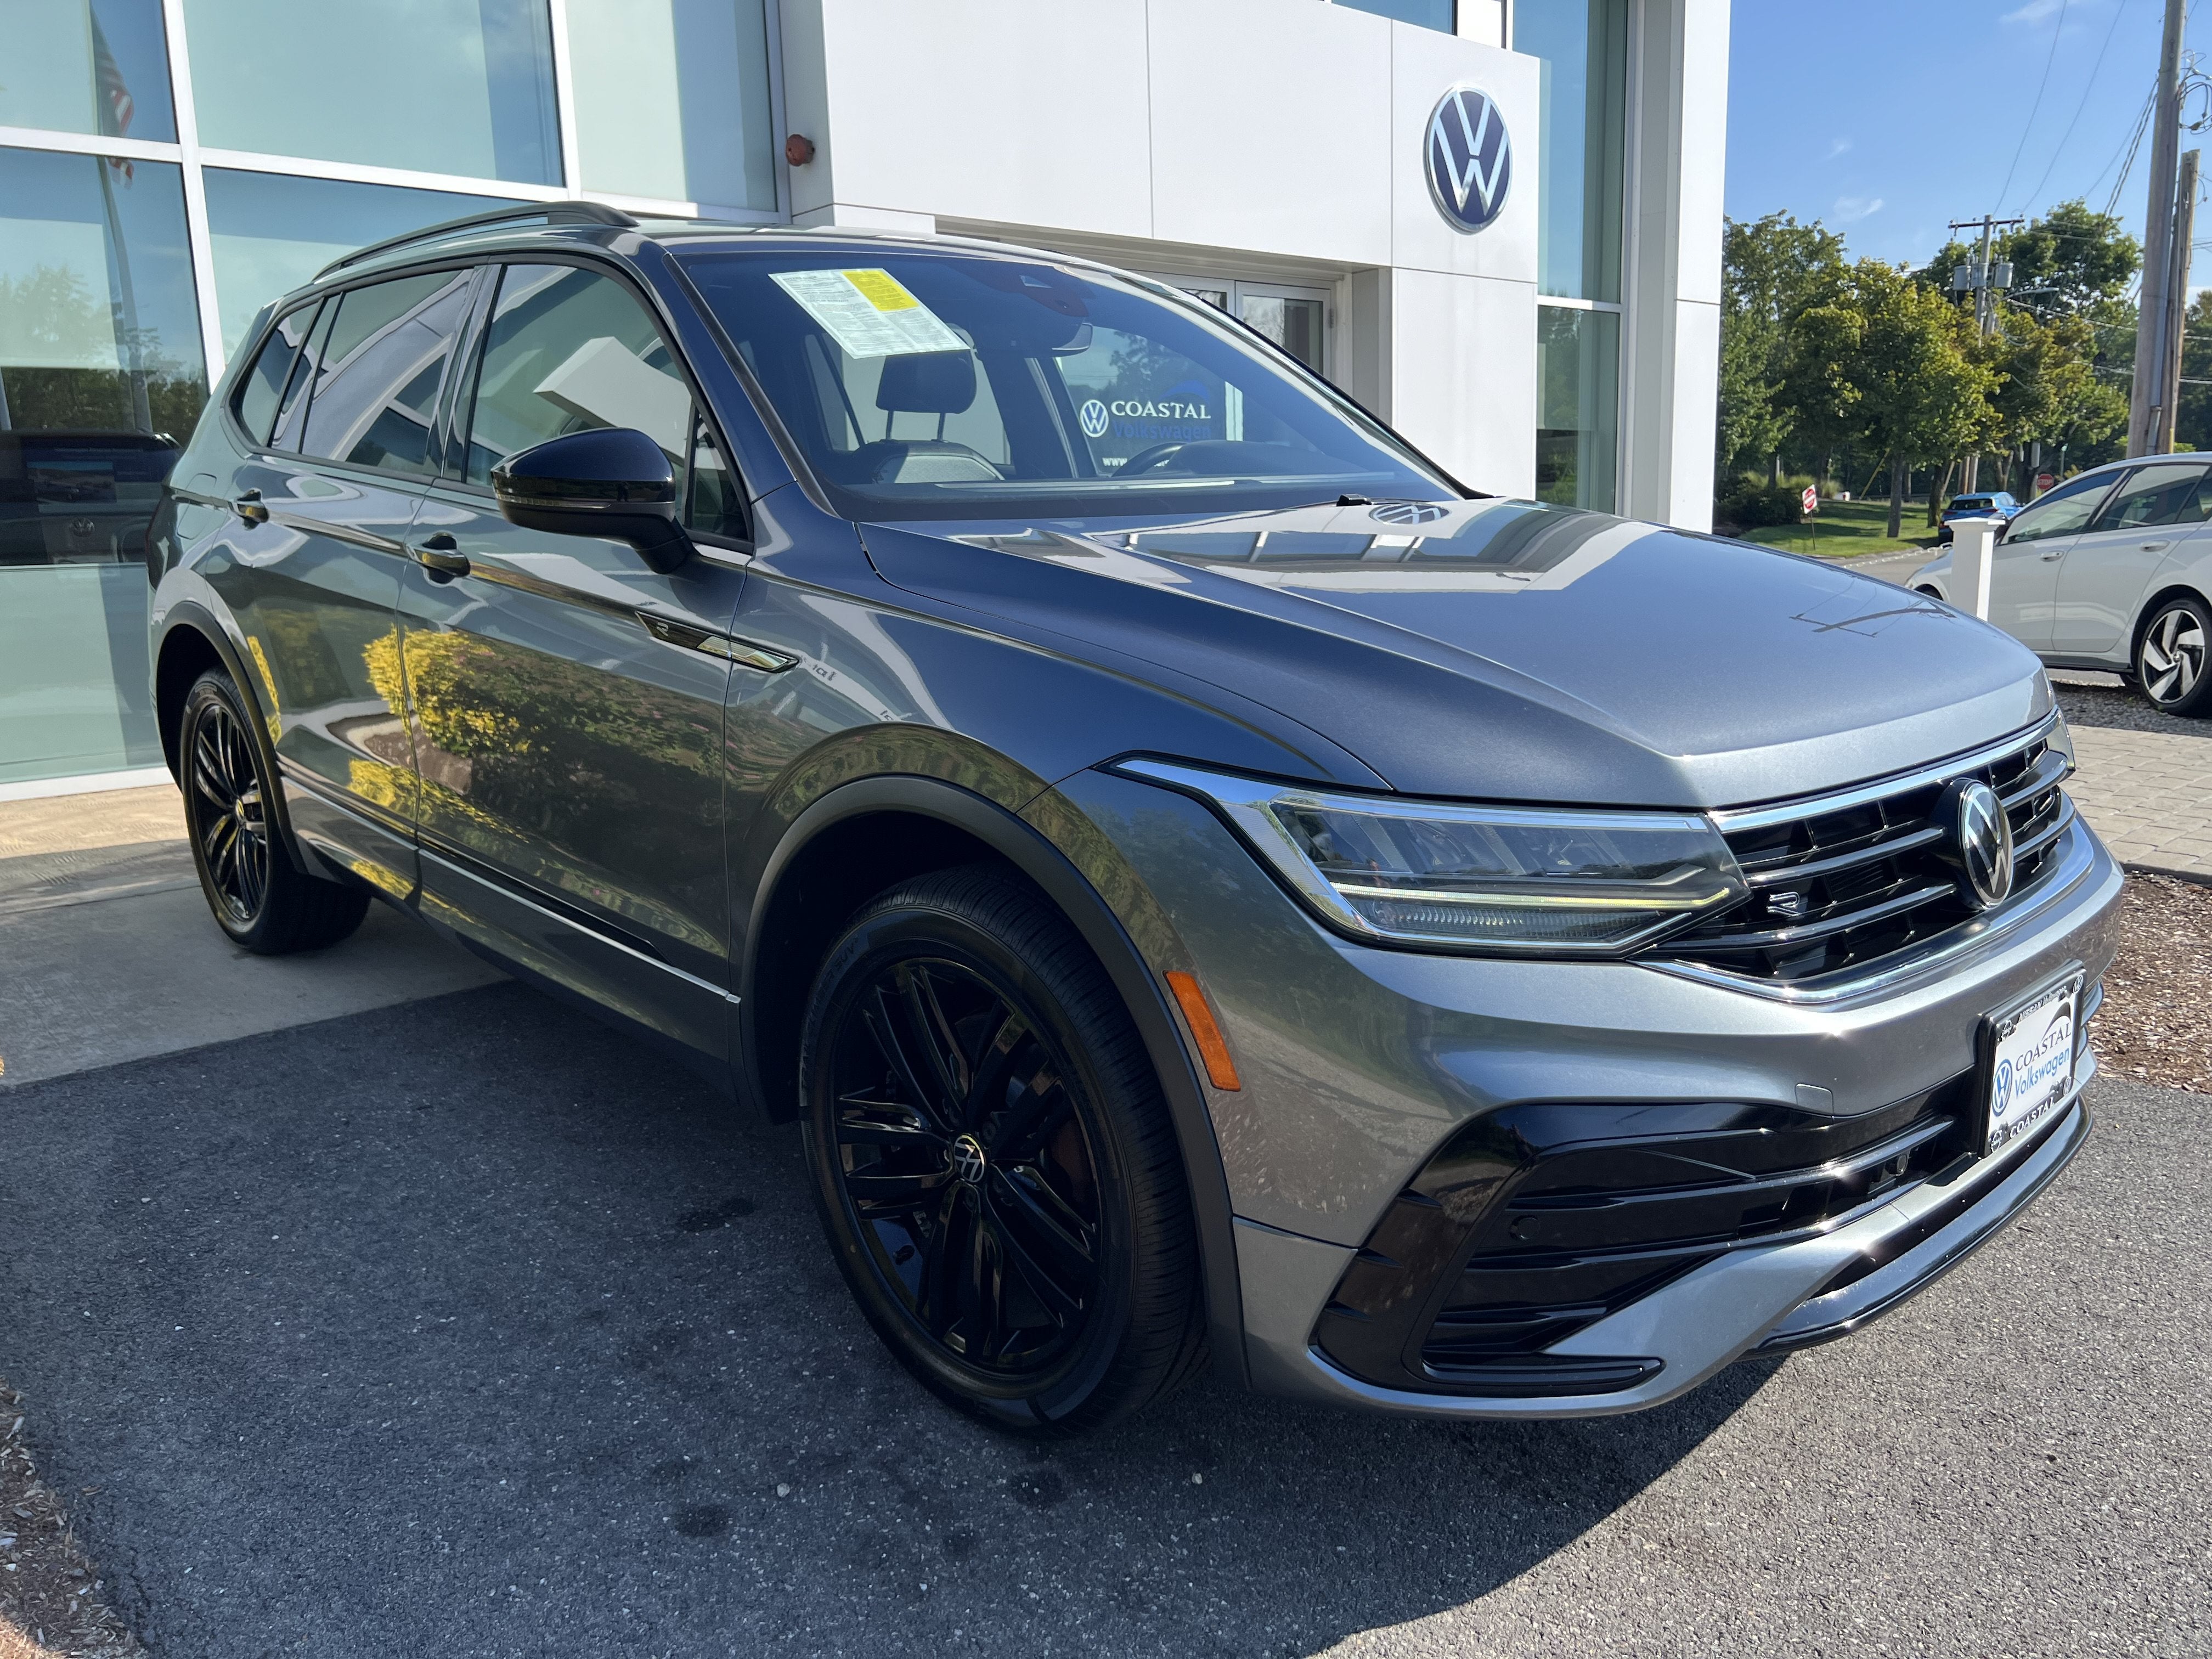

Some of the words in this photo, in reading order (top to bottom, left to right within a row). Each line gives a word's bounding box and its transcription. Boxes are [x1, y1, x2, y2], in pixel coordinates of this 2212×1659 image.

[1110, 400, 1211, 419] COASTAL
[1111, 420, 1211, 442] Volkswagen
[2016, 1022, 2072, 1071] COASTAL
[2015, 1047, 2069, 1099] Volkswagen
[2010, 1096, 2056, 1138] COASTAL
